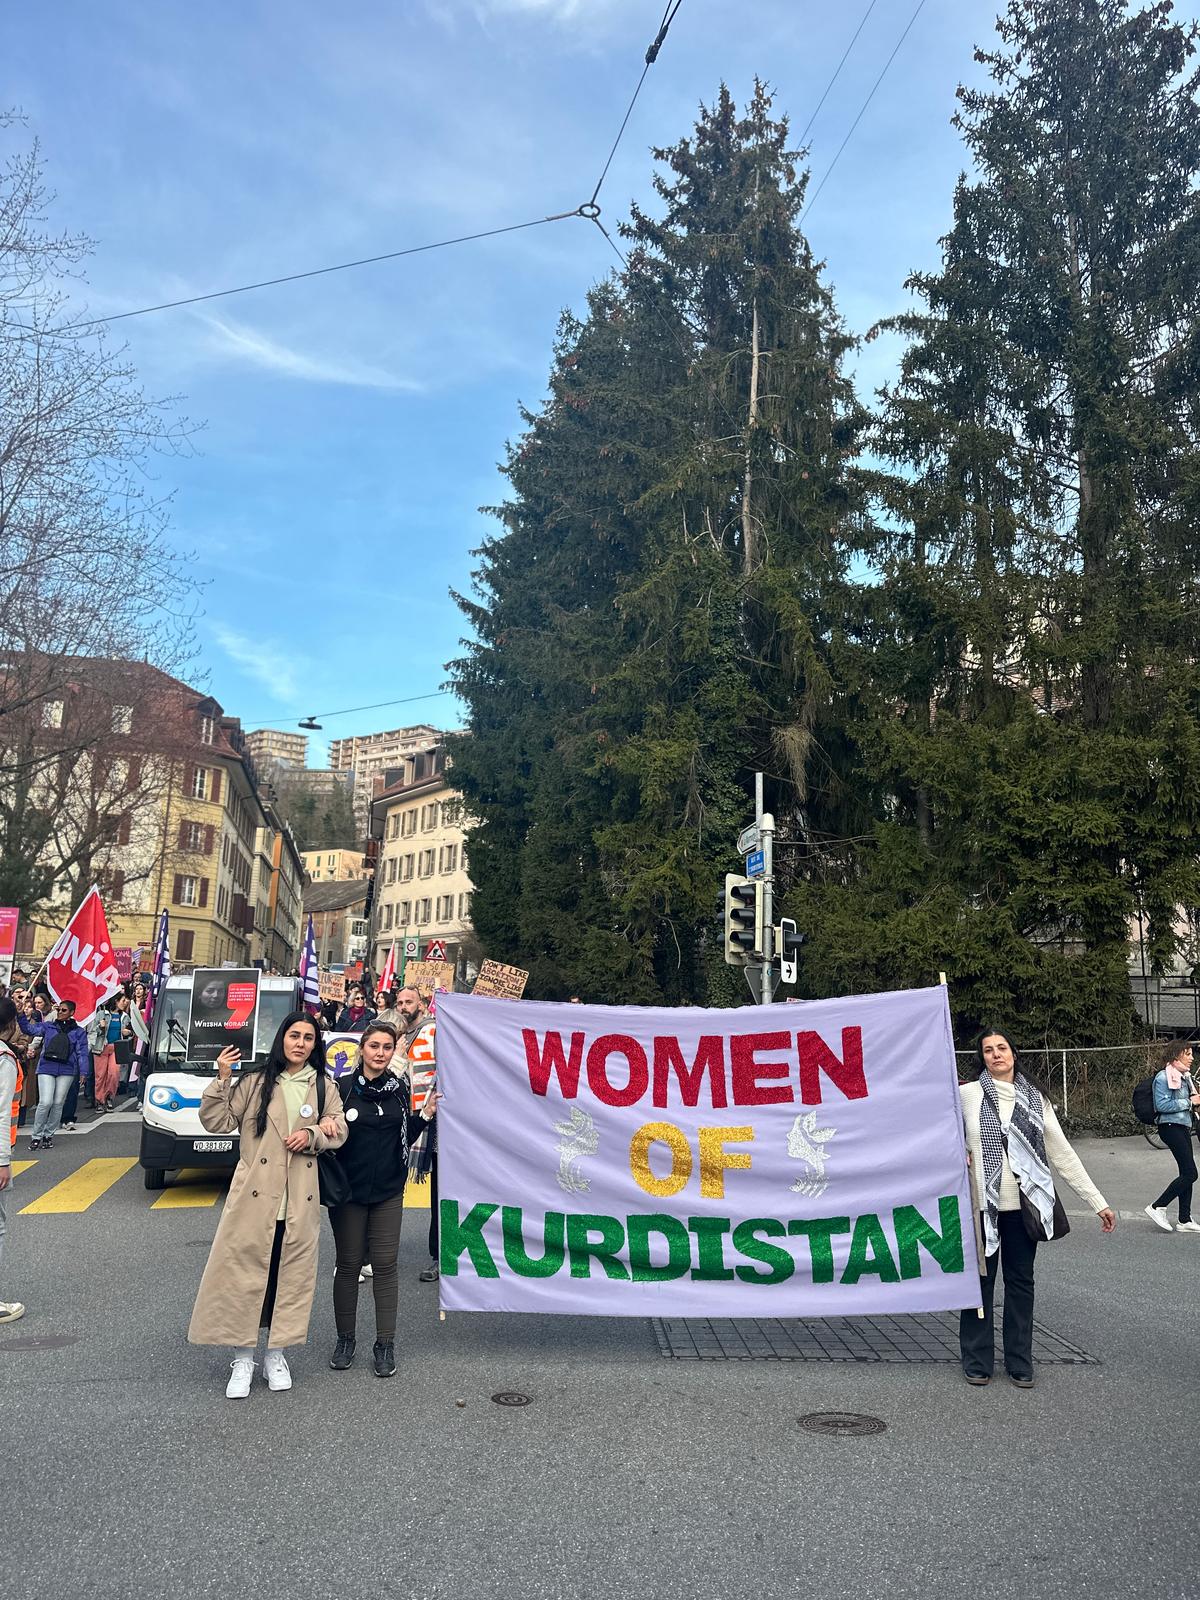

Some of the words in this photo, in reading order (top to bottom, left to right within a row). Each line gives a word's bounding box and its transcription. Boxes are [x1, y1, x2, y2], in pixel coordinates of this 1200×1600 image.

[507, 983, 523, 993] LIKE
[509, 967, 528, 979] LIKE
[522, 1026, 868, 1108] WOMEN
[629, 1122, 754, 1199] OF
[440, 1195, 965, 1285] KURDISTAN
